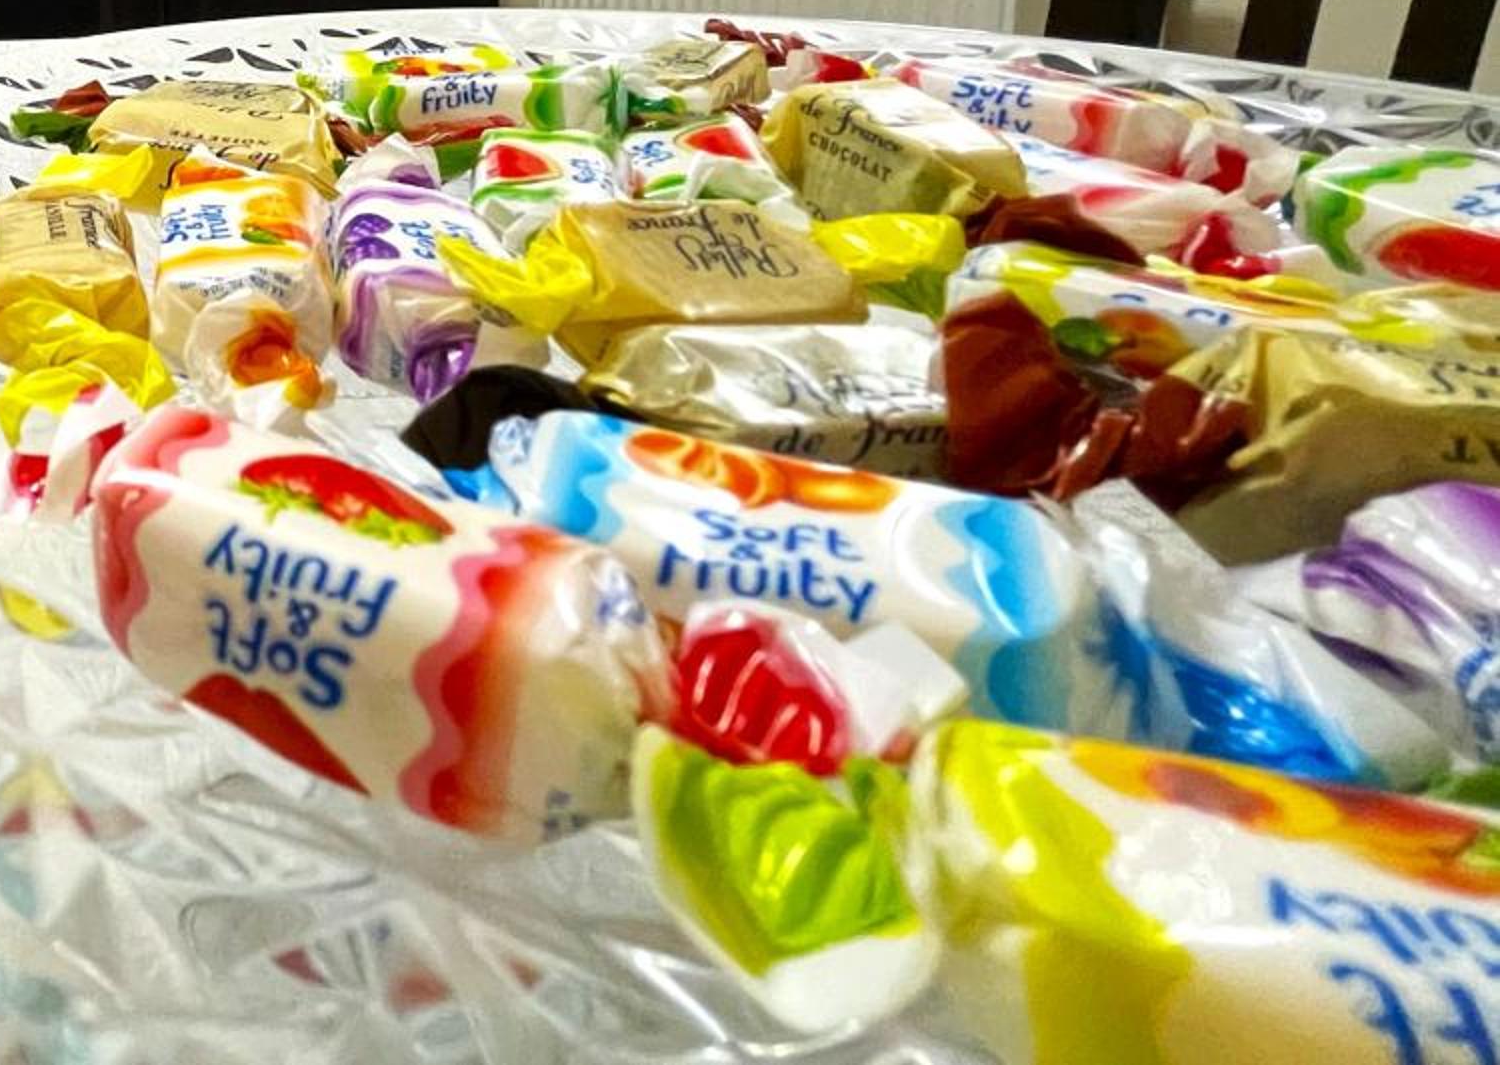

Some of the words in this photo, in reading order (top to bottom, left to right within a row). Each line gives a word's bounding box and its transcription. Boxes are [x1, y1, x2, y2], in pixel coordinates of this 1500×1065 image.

[809, 131, 892, 183] CHOCOLAT
[731, 212, 761, 241] de
[773, 426, 824, 454] de
[693, 509, 864, 562] Soft
[286, 597, 321, 639] &
[204, 596, 355, 711] Soft
